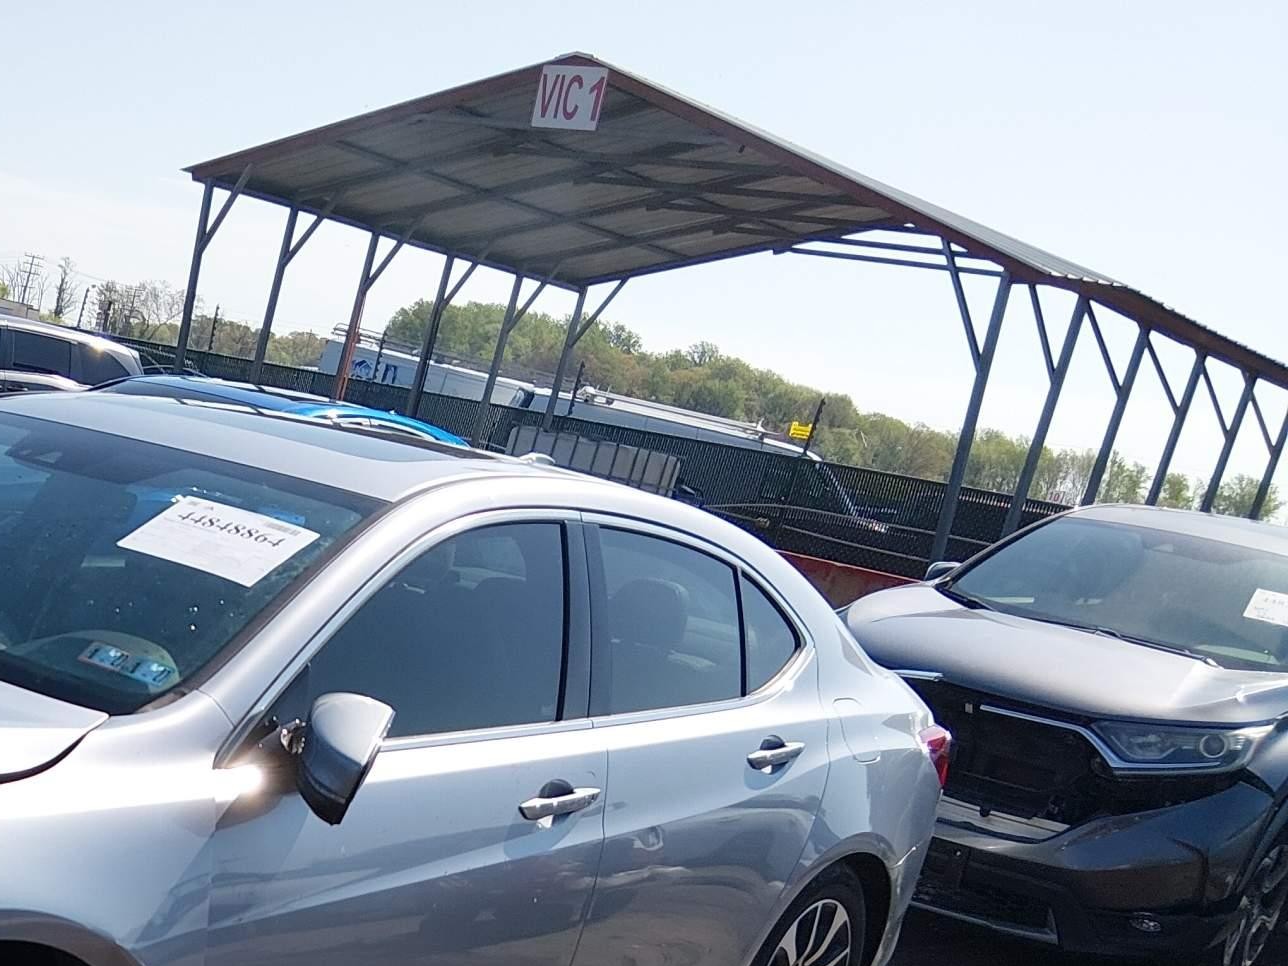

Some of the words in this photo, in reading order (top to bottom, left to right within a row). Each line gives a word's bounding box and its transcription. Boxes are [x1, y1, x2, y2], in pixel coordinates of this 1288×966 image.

[540, 73, 584, 121] VIC
[589, 76, 606, 122] 1
[177, 511, 286, 548] 44848864
